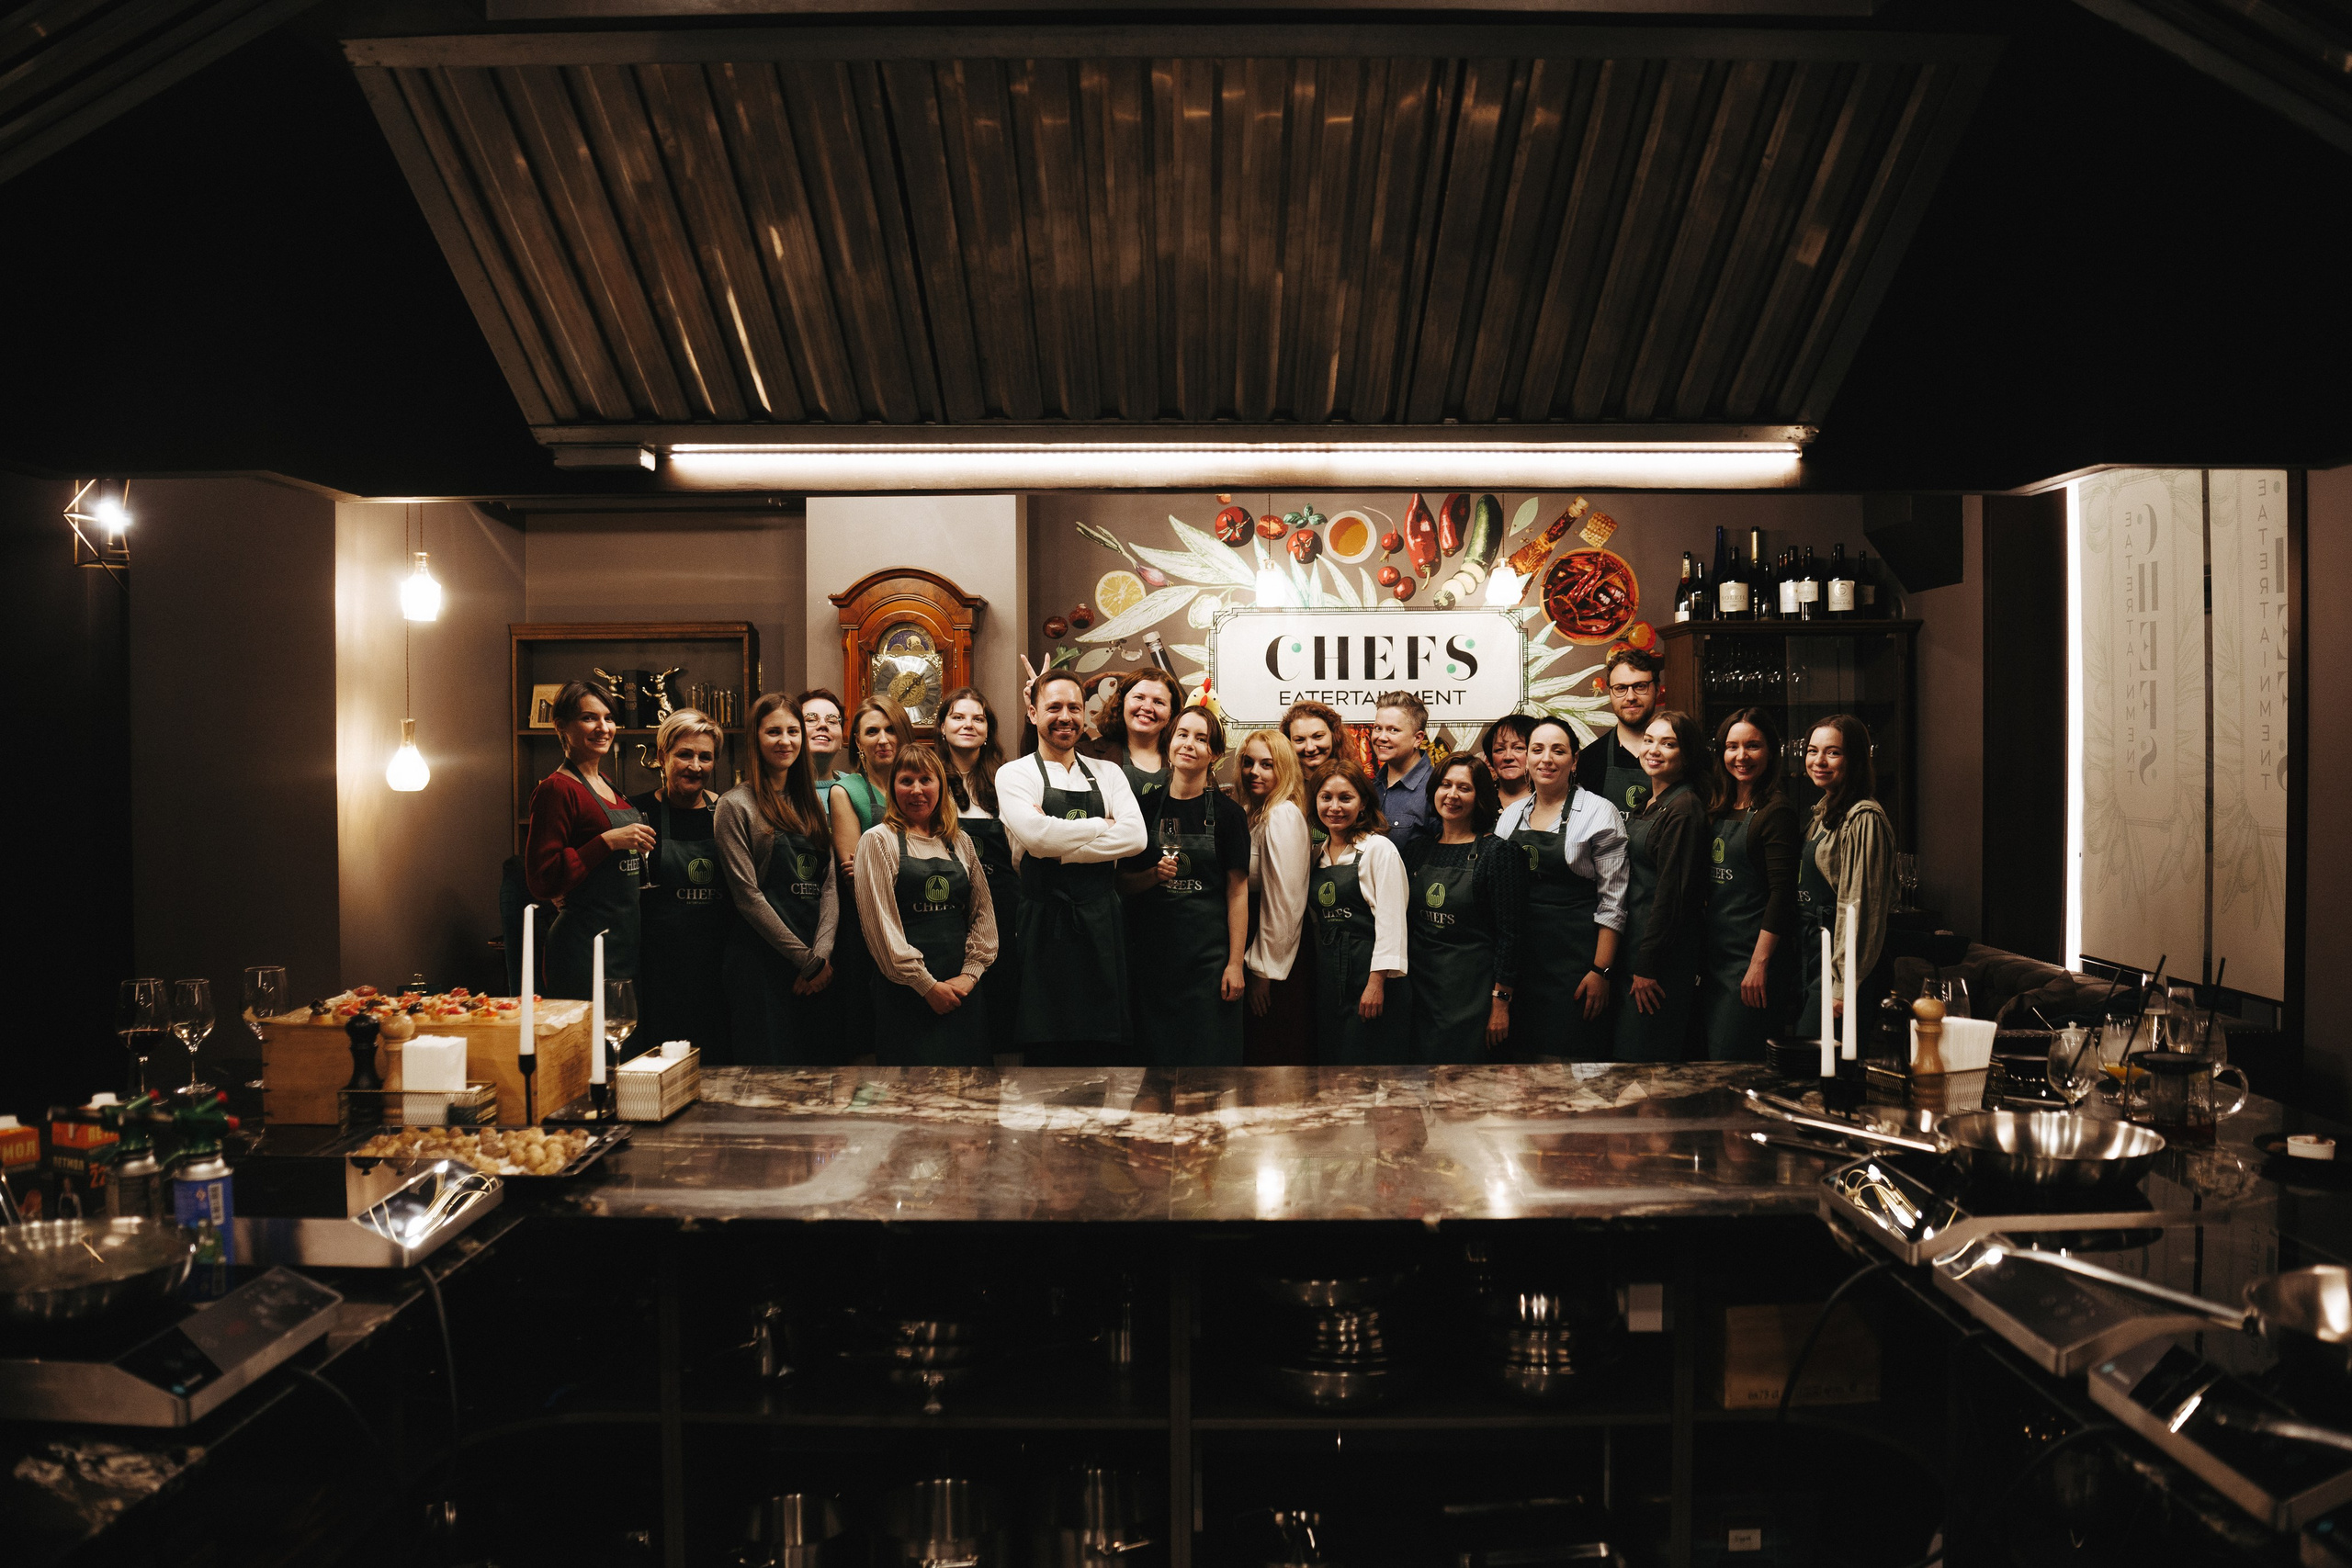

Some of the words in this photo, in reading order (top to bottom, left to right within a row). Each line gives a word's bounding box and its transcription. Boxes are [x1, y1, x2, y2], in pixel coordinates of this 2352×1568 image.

[1265, 635, 1478, 681] CHEFS
[1279, 690, 1466, 706] EATERTAENT
[1711, 866, 1734, 881] HEFS
[676, 888, 723, 901] CHEFS
[1419, 909, 1456, 925] CHEFS
